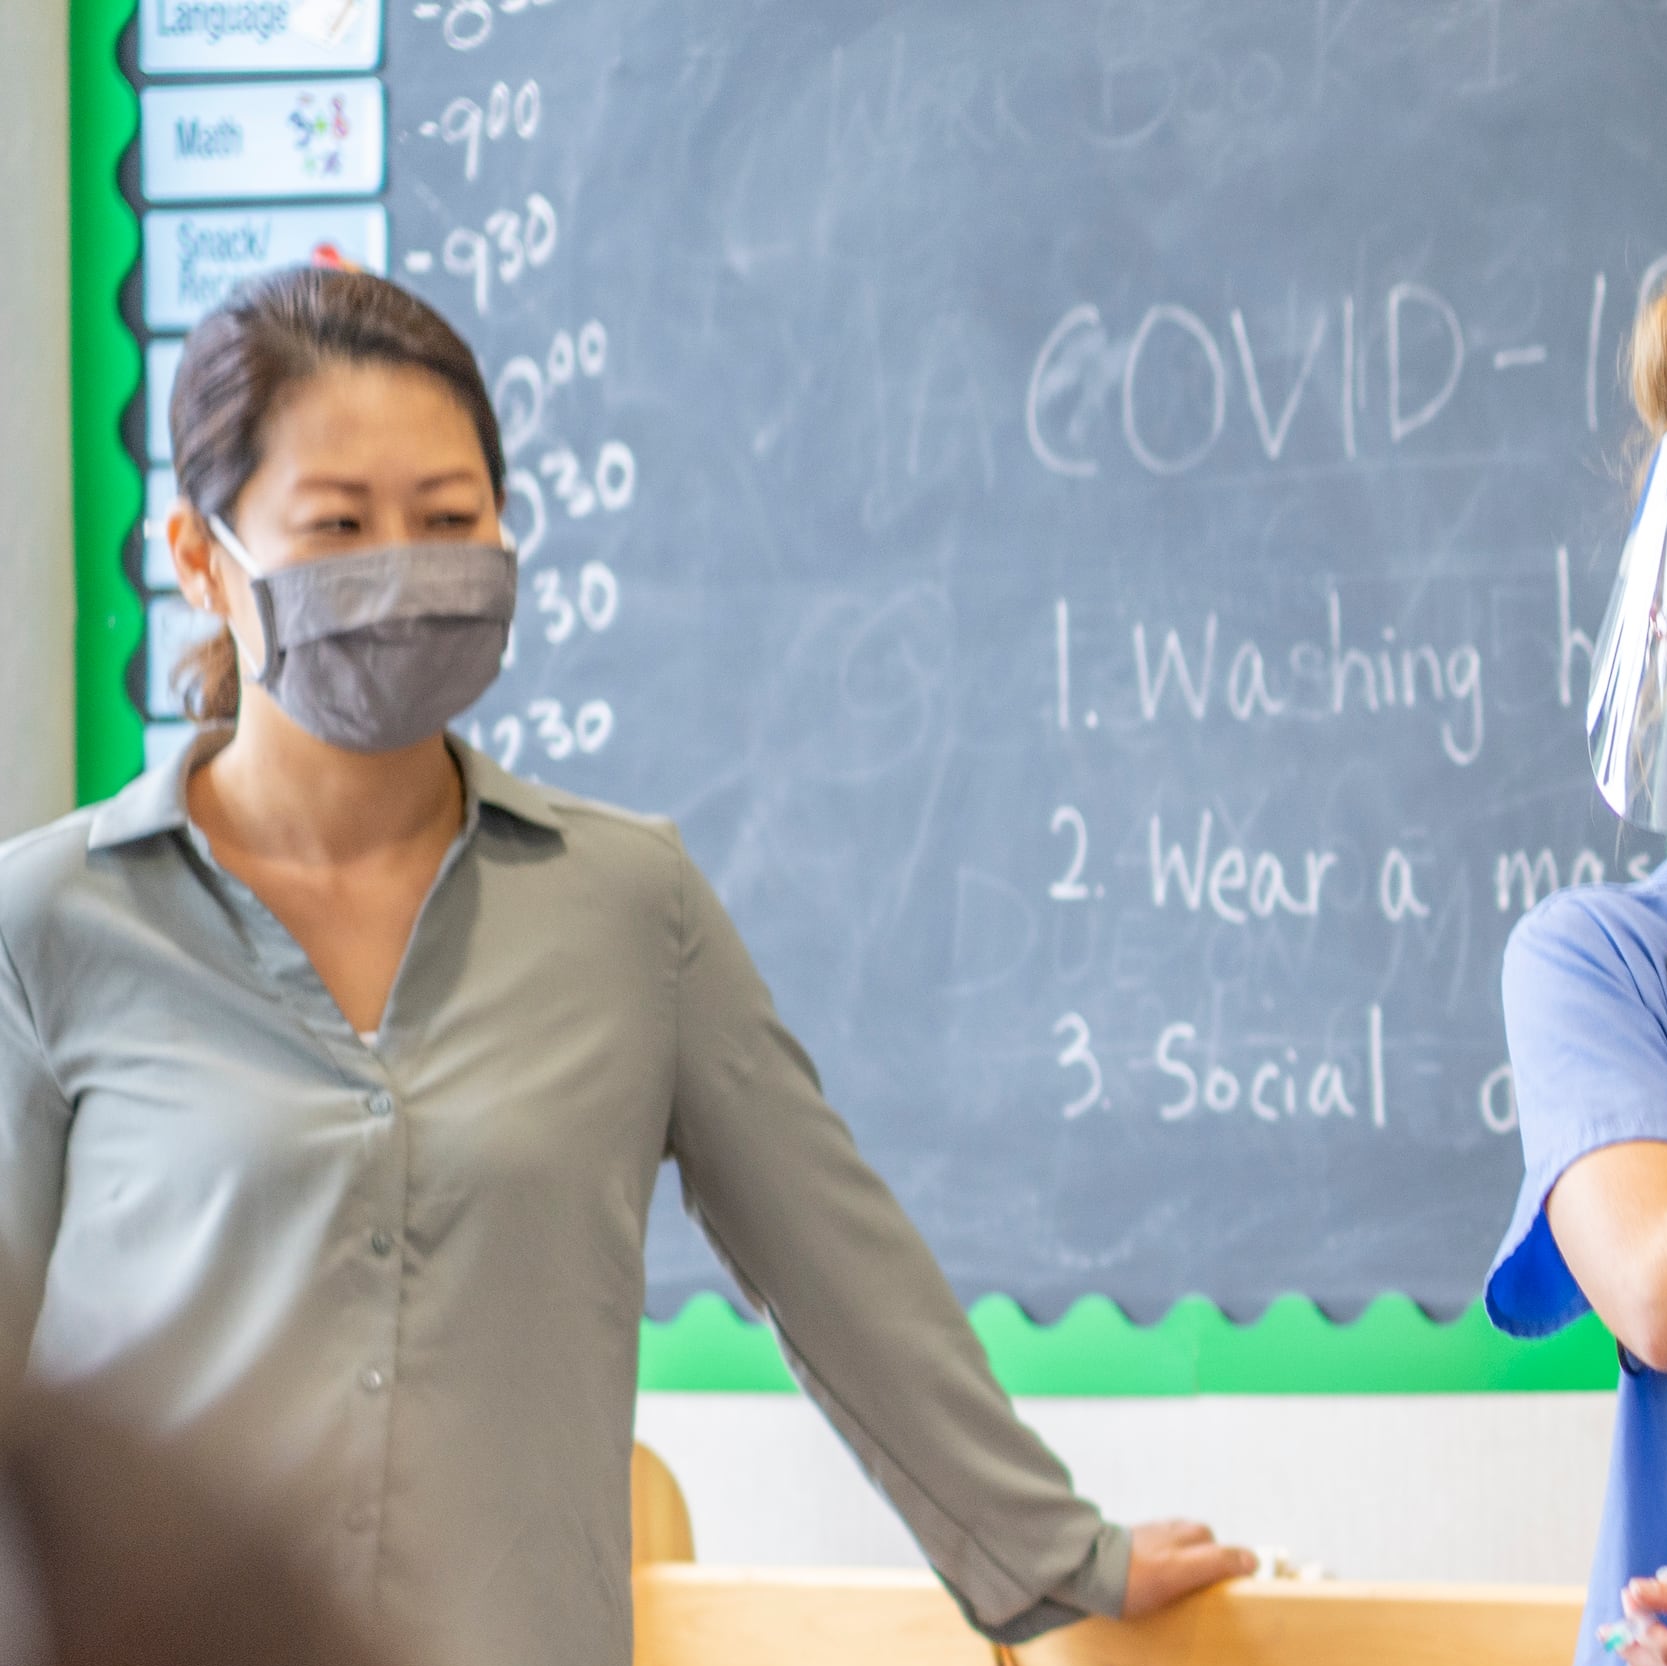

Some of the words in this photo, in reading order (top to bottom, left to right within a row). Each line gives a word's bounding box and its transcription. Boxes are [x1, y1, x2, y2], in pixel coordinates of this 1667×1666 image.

[1134, 581, 1484, 766] Washing
[1150, 810, 1336, 923] Wear
[1381, 855, 1428, 920] a
[1152, 1005, 1386, 1127] Social
